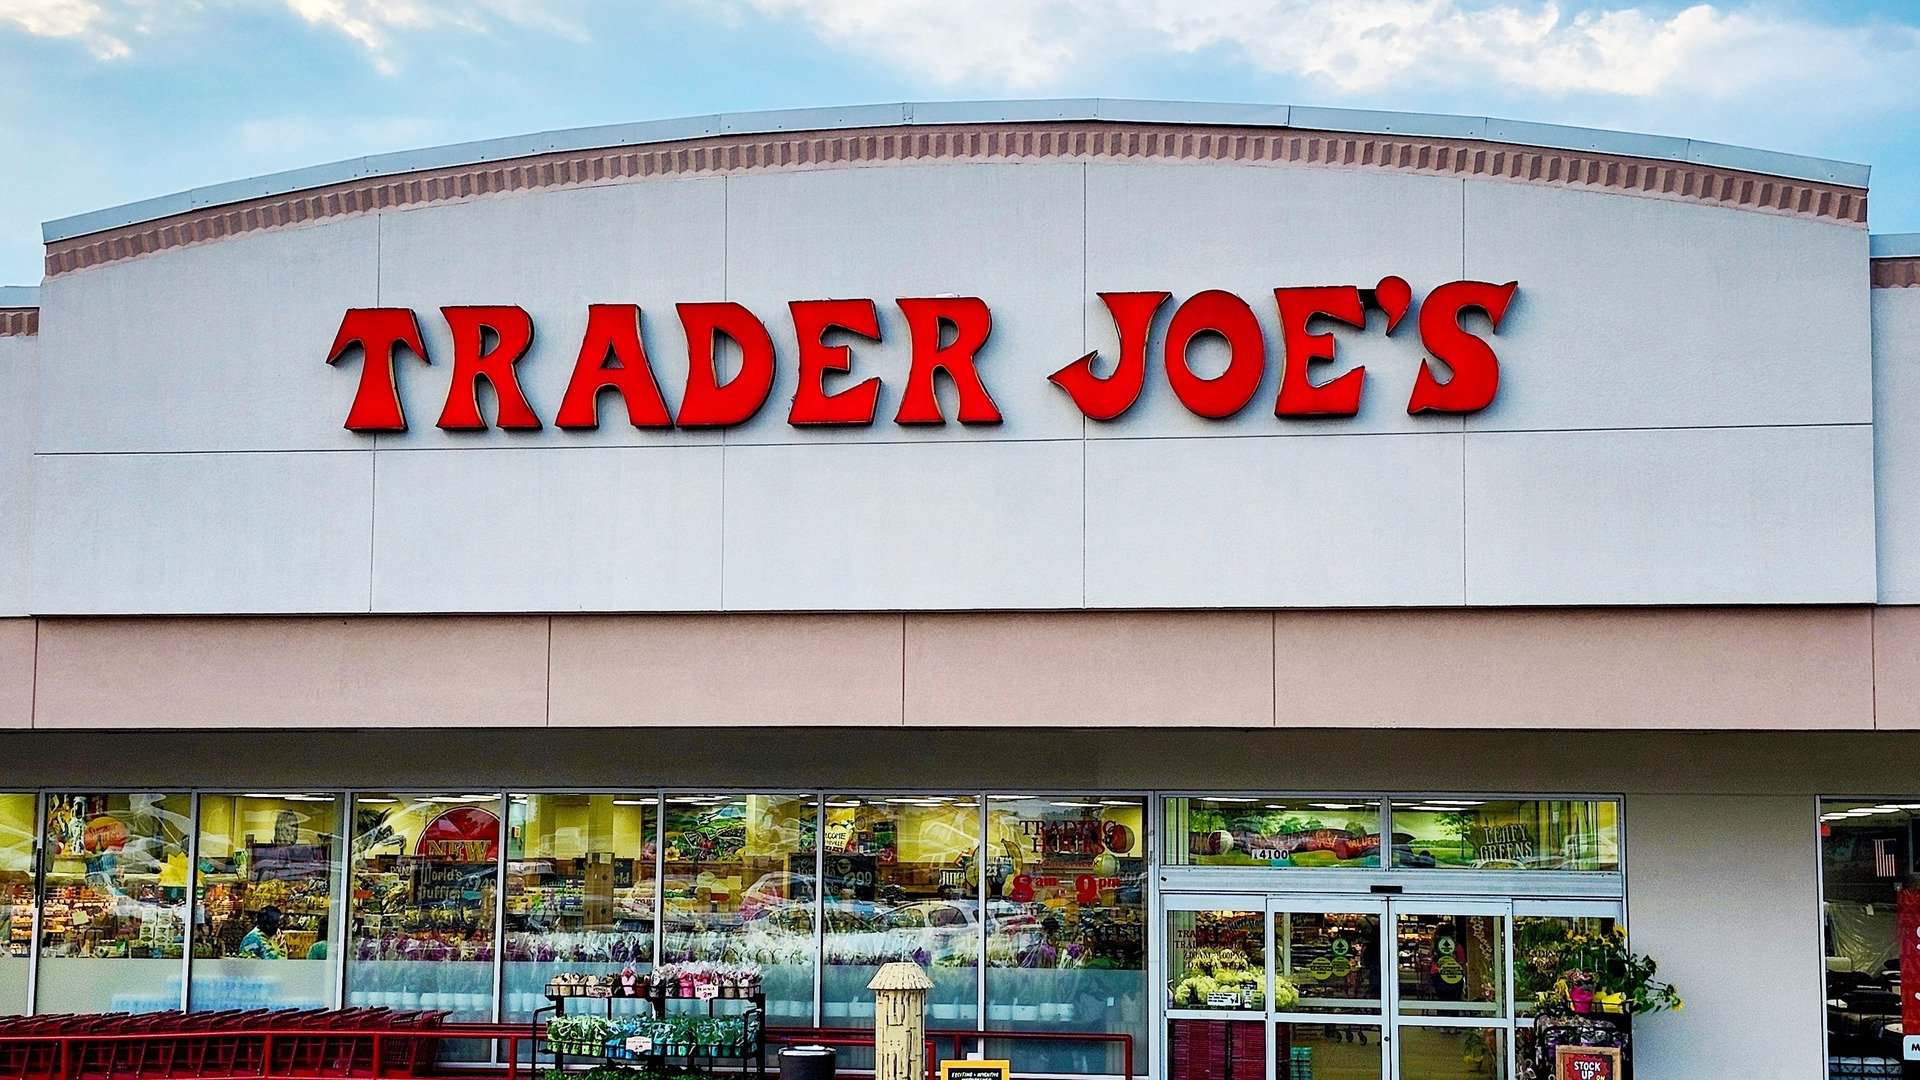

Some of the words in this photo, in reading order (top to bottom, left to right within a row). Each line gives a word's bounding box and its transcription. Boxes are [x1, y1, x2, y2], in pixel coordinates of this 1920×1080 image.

[326, 298, 1003, 432] TRADER
[1048, 274, 1520, 423] JOE'S
[1484, 823, 1528, 844] LEAFY
[427, 839, 491, 863] NEW
[1480, 841, 1533, 861] GREENS
[1574, 1061, 1601, 1071] STOCK
[1582, 1071, 1594, 1079] UP
